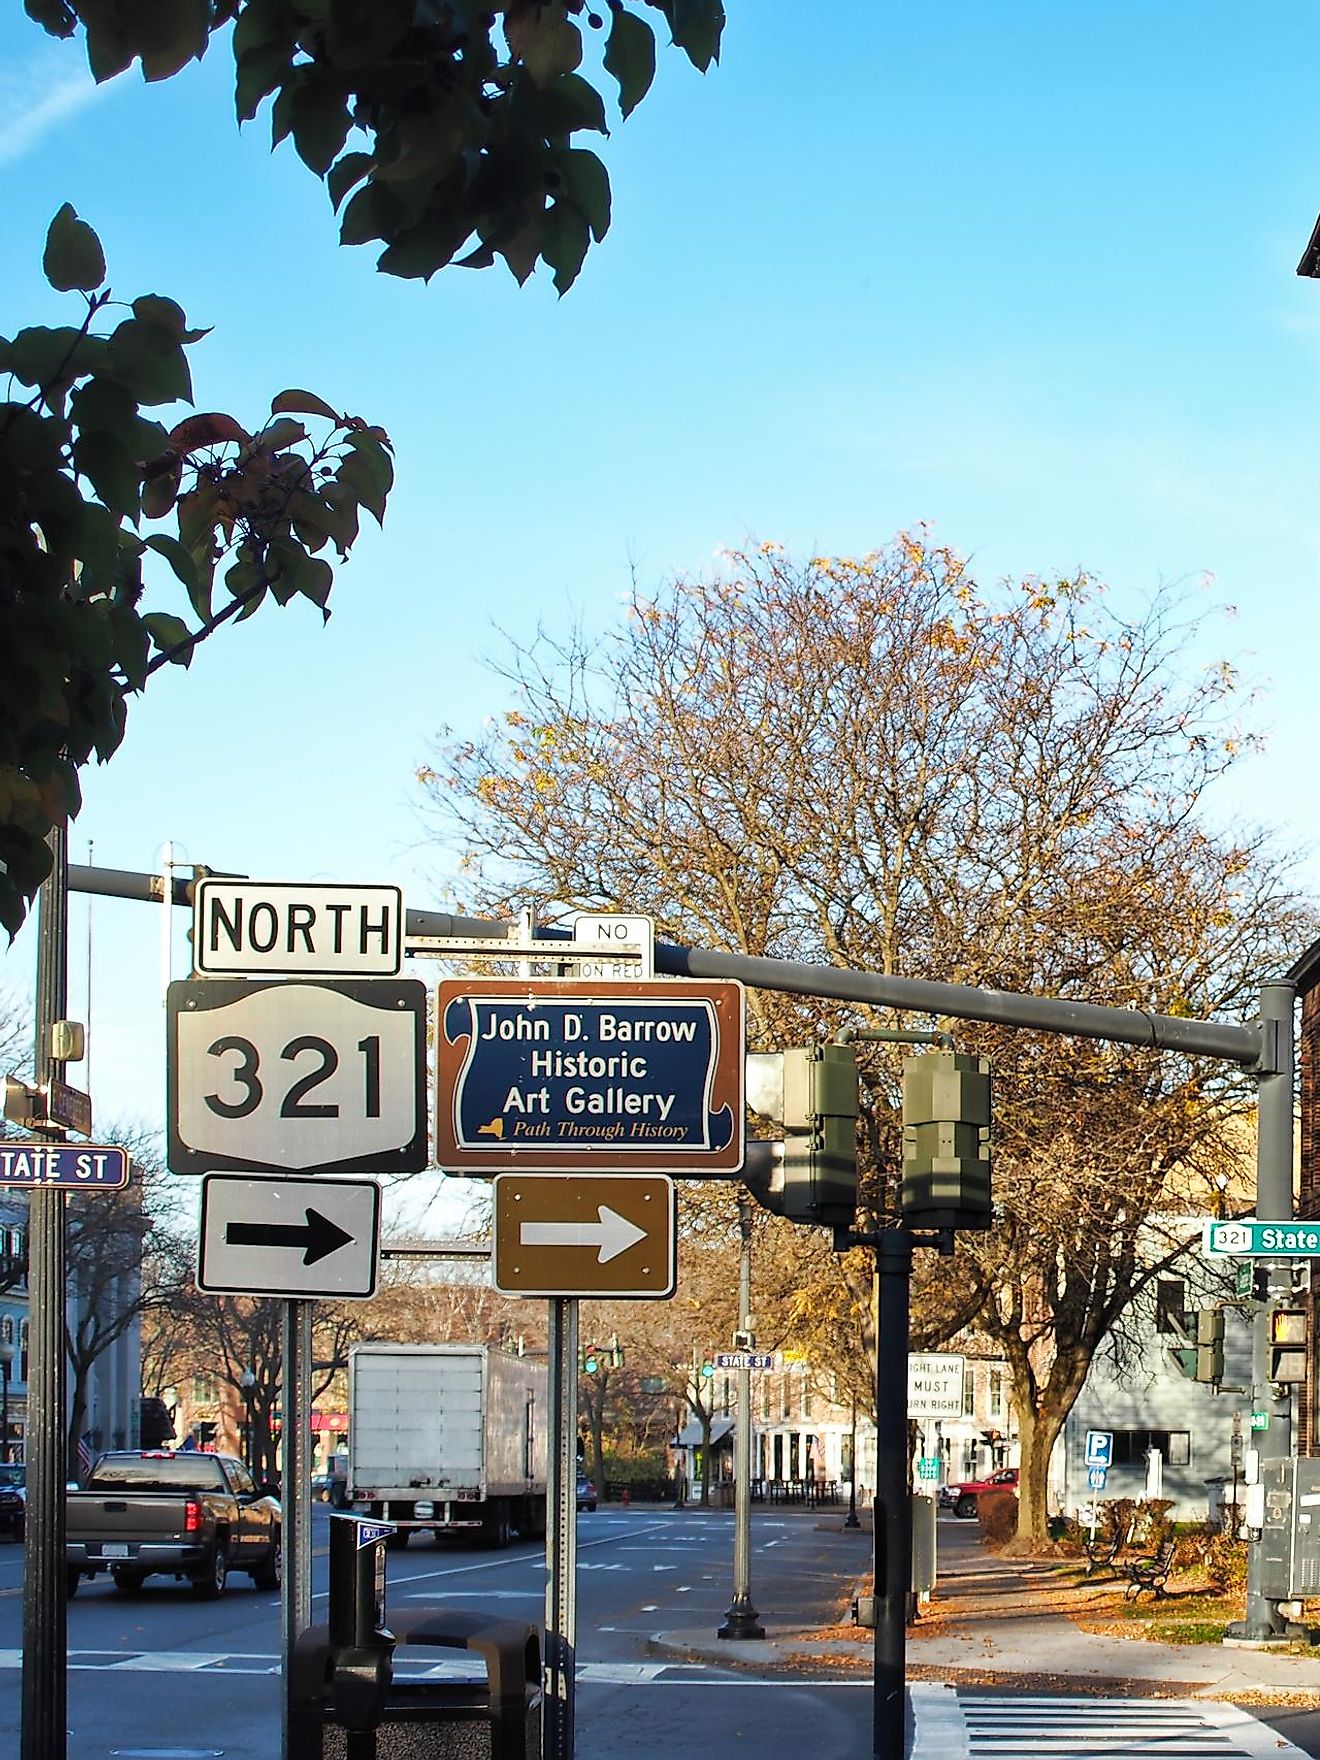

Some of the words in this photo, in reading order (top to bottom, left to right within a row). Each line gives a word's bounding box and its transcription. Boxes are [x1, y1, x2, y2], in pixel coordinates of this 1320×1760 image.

[210, 897, 389, 955] NORTH
[597, 923, 628, 940] NO
[582, 963, 604, 977] ON
[612, 964, 643, 978] RED
[481, 1013, 550, 1041] John
[563, 1013, 589, 1042] D.
[599, 1014, 697, 1042] Barrow
[531, 1050, 647, 1078] Historic
[203, 1035, 380, 1119] 321
[502, 1086, 550, 1114] Art
[565, 1087, 675, 1121] Gallery
[513, 1121, 551, 1137] Path
[557, 1121, 625, 1141] Through
[629, 1122, 688, 1141] History
[0, 1152, 61, 1178] TATE
[75, 1154, 108, 1180] ST
[1218, 1231, 1247, 1245] 321
[1261, 1228, 1319, 1250] State
[721, 1355, 751, 1367] STATE
[754, 1356, 767, 1368] ST
[909, 1363, 931, 1374] IGHT
[936, 1364, 960, 1374] LANE
[914, 1381, 948, 1392] MUST
[909, 1400, 927, 1409] URN
[931, 1400, 960, 1410] RIGHT
[1091, 1435, 1108, 1456] P
